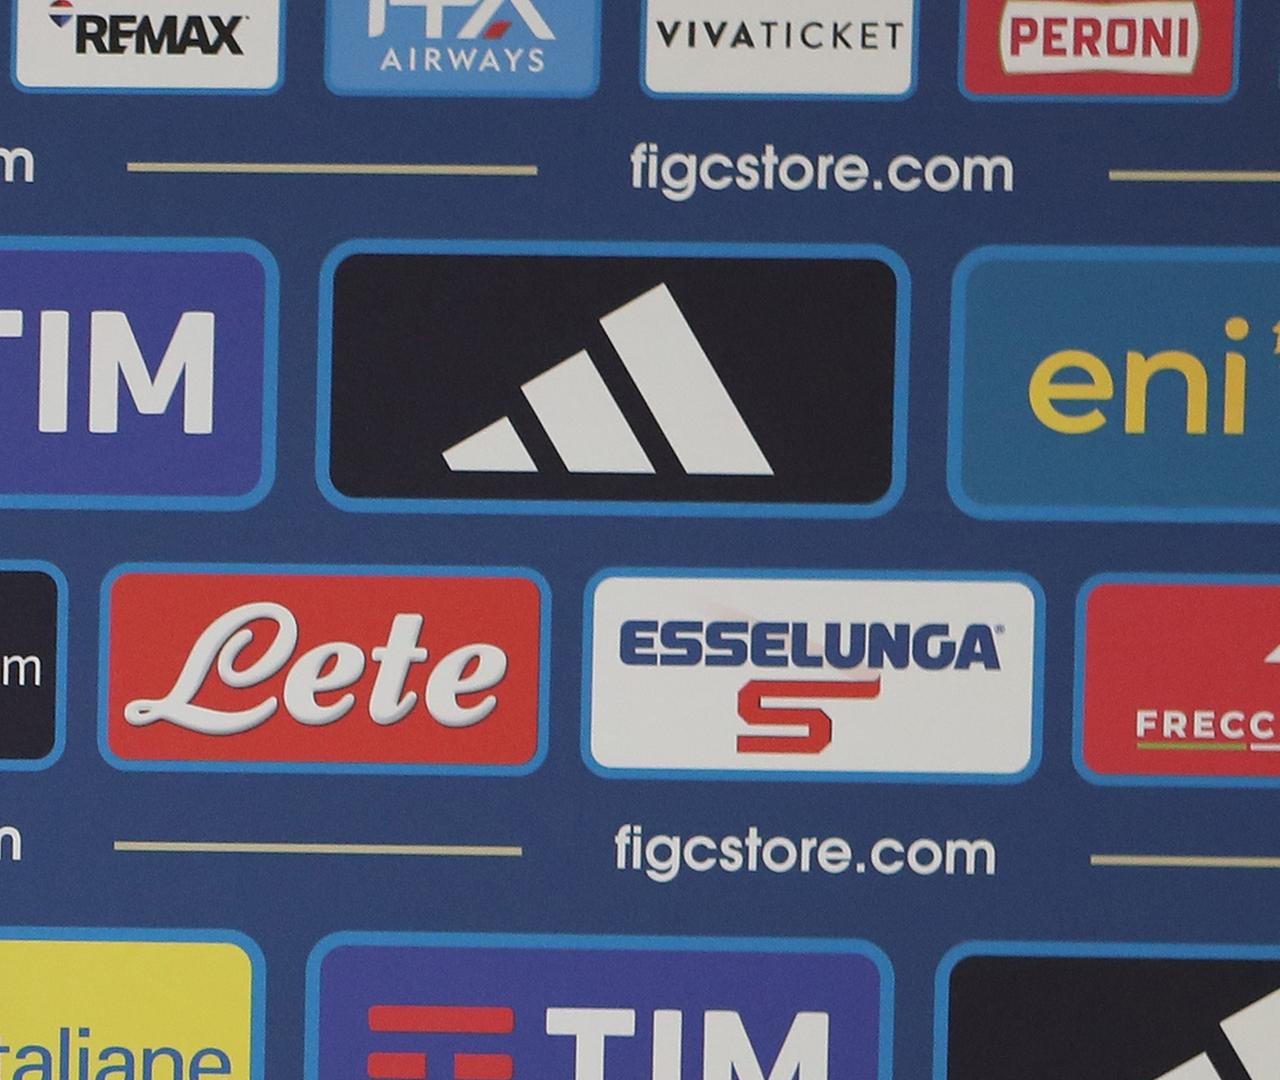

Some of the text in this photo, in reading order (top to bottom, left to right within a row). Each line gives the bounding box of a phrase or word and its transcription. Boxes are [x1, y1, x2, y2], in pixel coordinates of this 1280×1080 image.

[382, 49, 544, 73] AIRWAYS
[658, 22, 904, 50] VIVATICKET
[1012, 18, 1189, 58] PERONI
[632, 144, 1014, 202] figcstore.com
[1030, 318, 1250, 435] eni
[124, 601, 507, 736] Lete
[616, 825, 996, 883] figcstore.com
